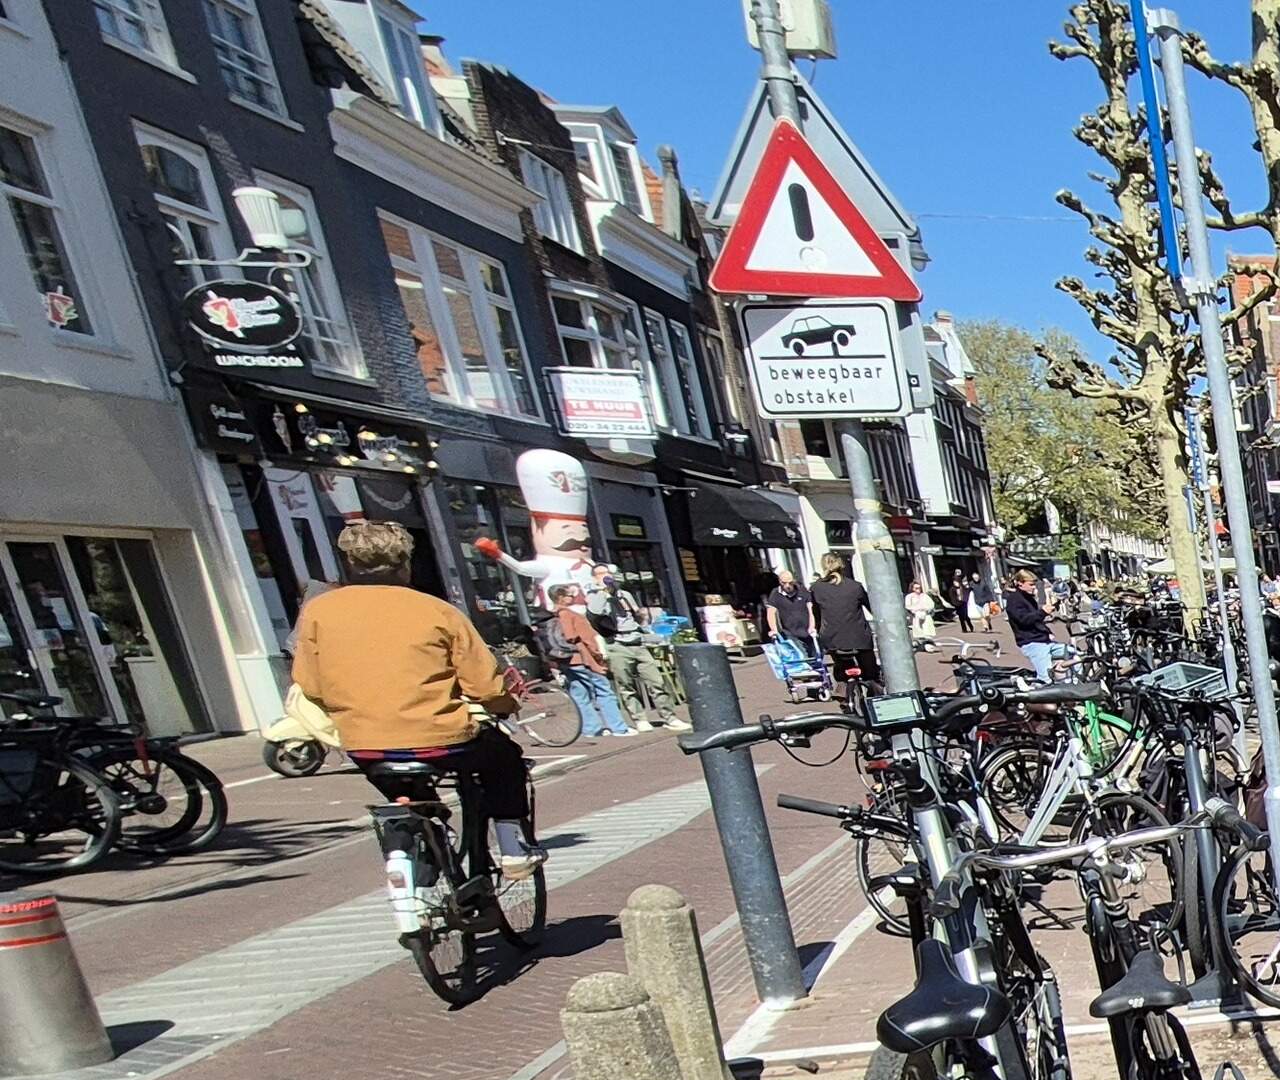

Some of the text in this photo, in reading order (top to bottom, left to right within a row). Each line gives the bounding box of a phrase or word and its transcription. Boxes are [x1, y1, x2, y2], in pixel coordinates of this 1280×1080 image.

[768, 364, 883, 384] beweegbaar
[774, 388, 855, 405] obstakel
[569, 400, 636, 411] TE HUUR
